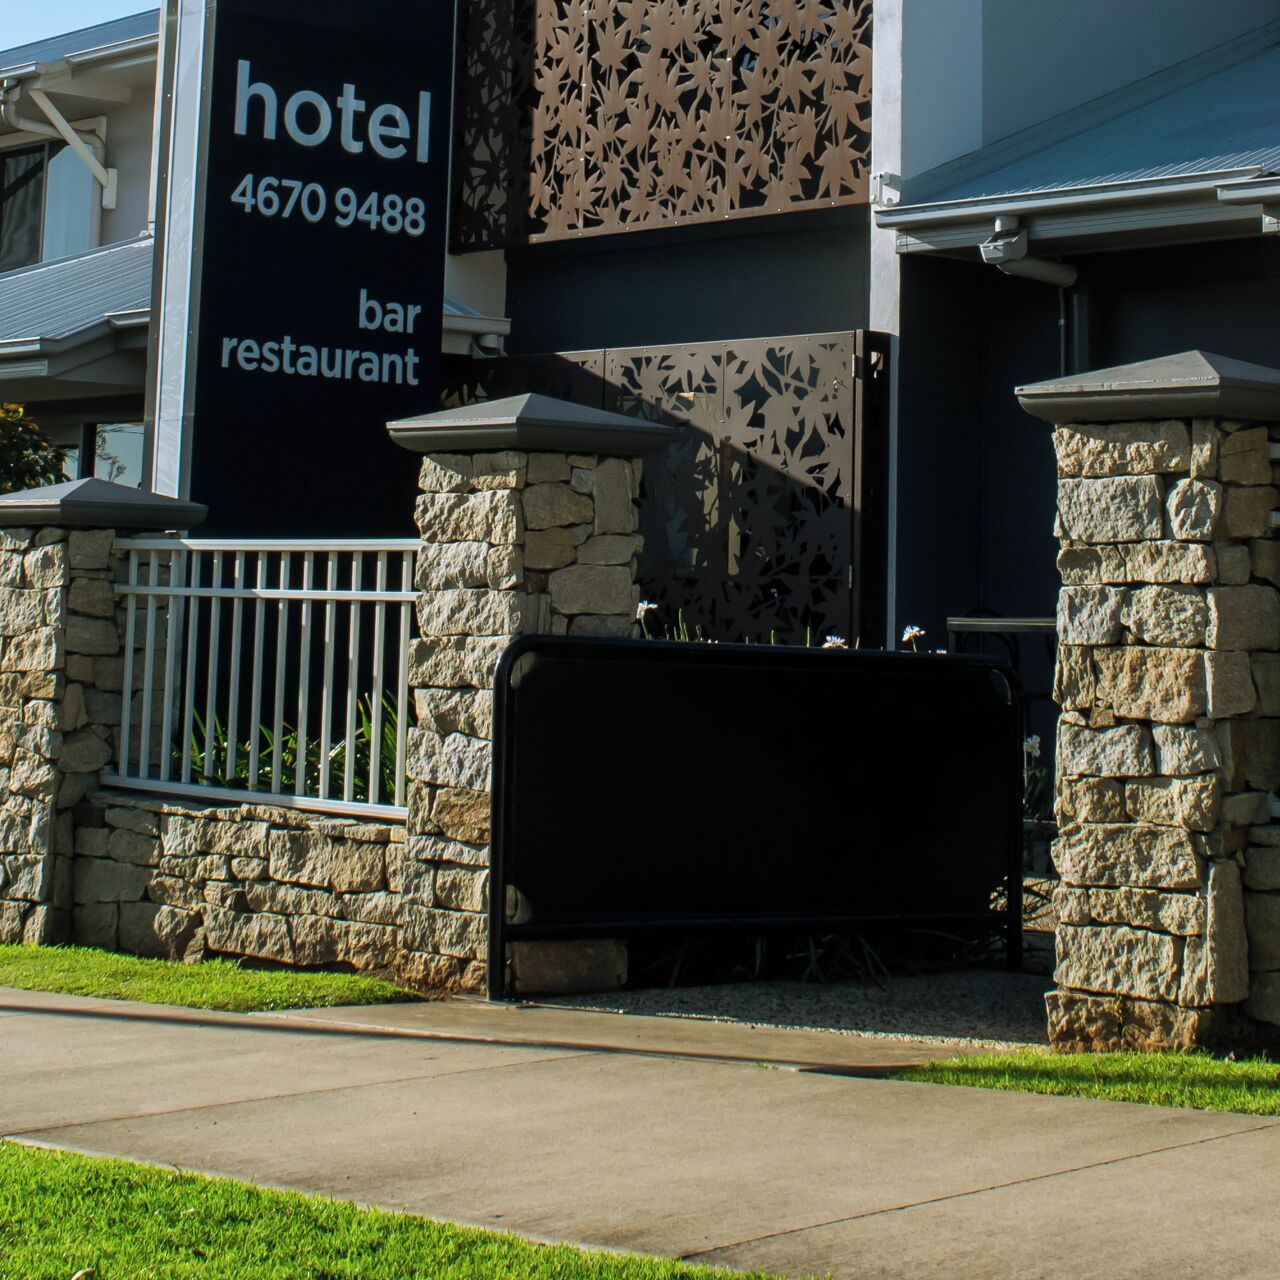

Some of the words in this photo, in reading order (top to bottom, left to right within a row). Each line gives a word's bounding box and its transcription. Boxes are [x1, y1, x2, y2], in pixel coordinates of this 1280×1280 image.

[231, 59, 432, 164] hotel
[230, 173, 327, 222] 4670
[334, 187, 426, 236] 9488
[358, 288, 422, 334] bar
[221, 335, 420, 386] restaurant
